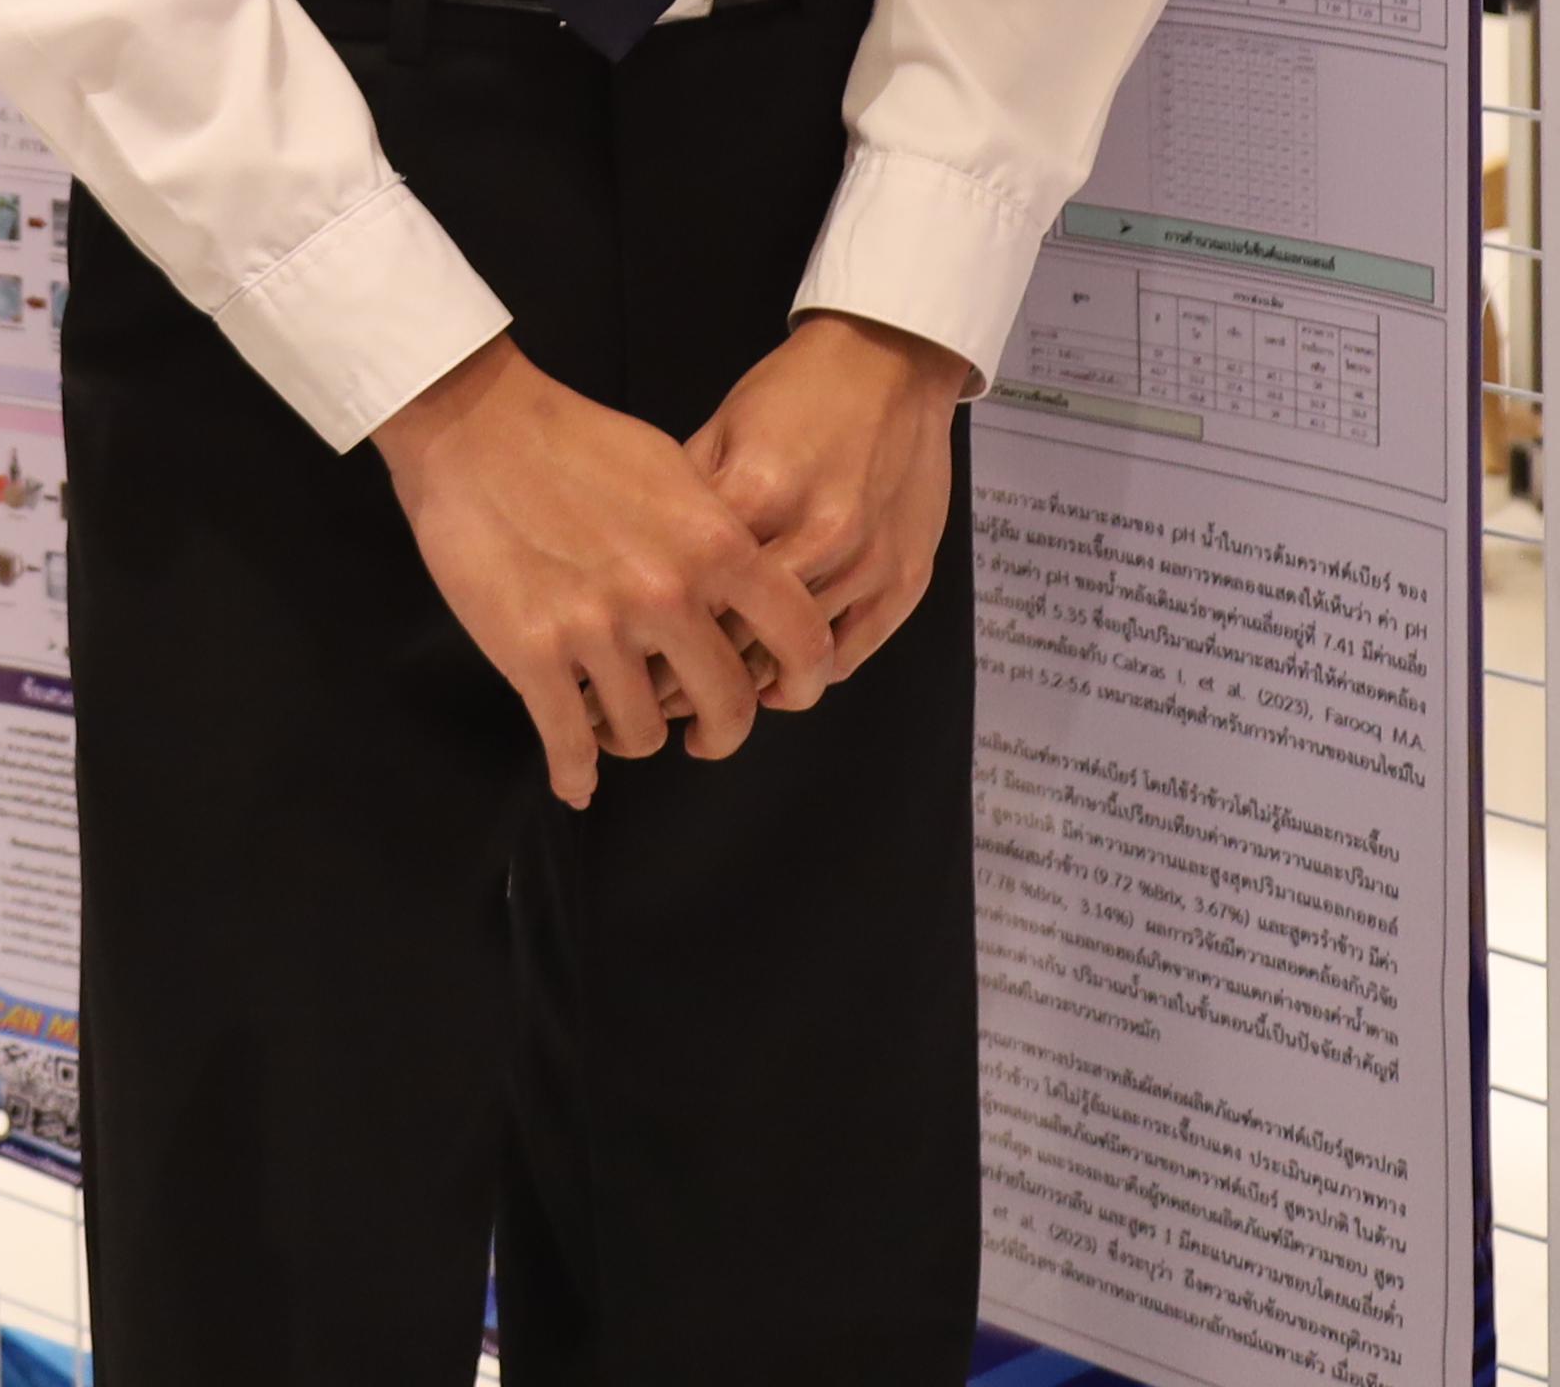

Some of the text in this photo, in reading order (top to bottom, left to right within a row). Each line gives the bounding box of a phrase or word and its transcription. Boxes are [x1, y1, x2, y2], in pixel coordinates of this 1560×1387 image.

[1171, 526, 1196, 546] pH
[1397, 581, 1429, 605] ของ
[1323, 631, 1355, 657] 7.41
[1404, 622, 1429, 642] pH
[1325, 706, 1383, 743] Farooq
